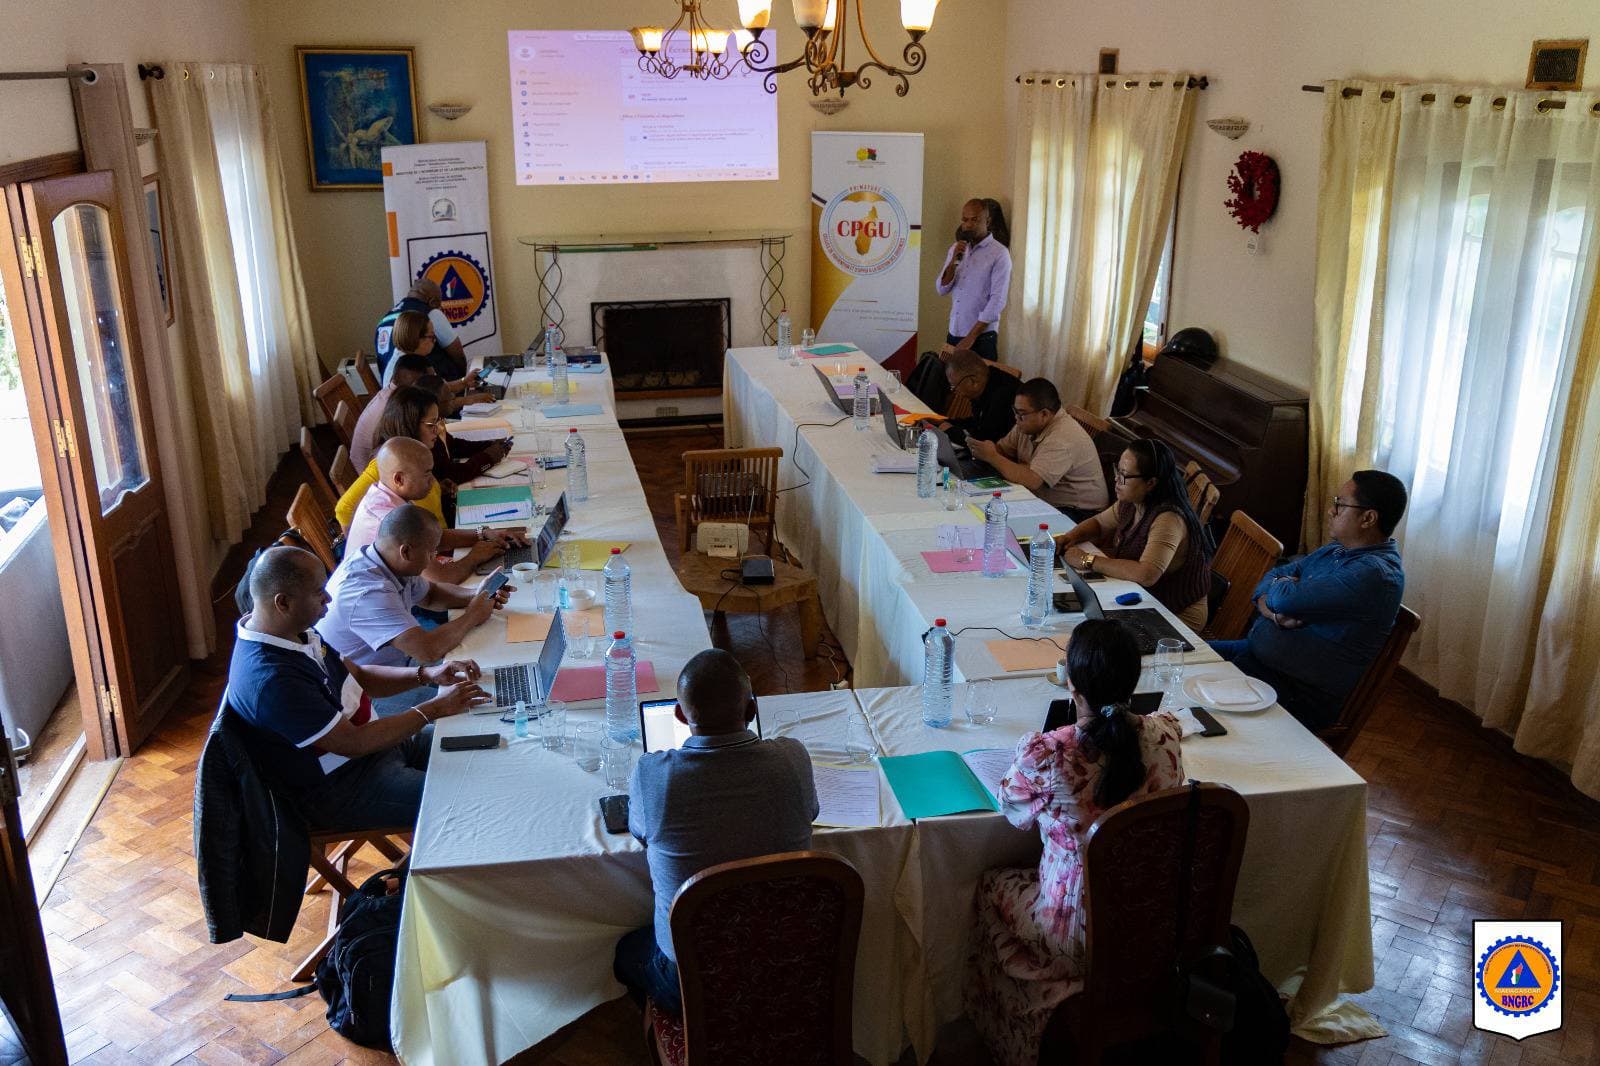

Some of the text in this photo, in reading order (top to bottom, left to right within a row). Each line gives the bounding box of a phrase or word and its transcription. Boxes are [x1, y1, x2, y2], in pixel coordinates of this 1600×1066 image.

[849, 184, 881, 193] PRIMATURE
[837, 220, 891, 239] CPGU
[441, 306, 469, 320] NGRC
